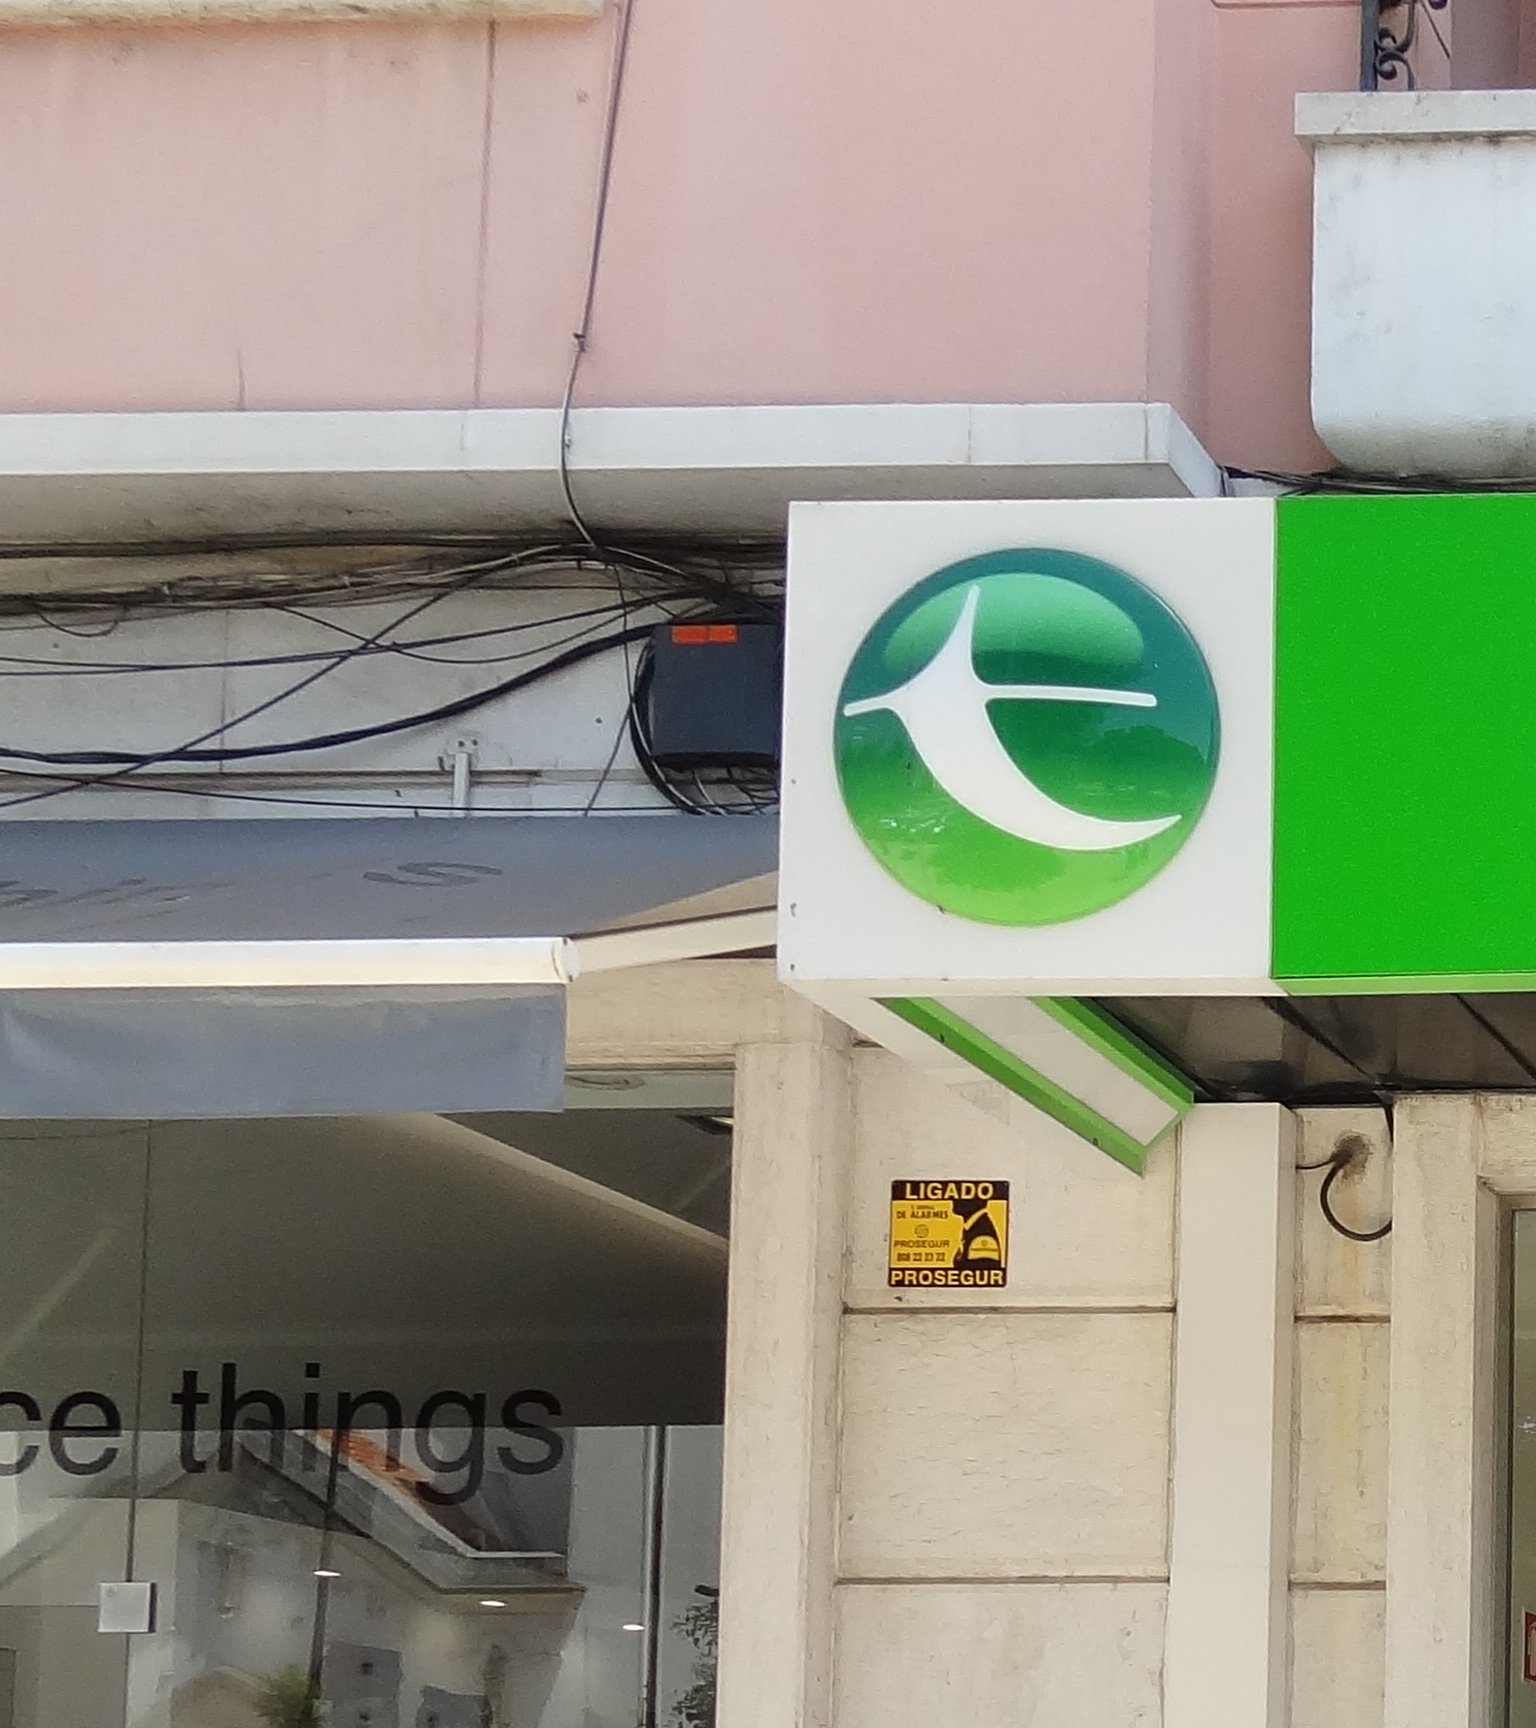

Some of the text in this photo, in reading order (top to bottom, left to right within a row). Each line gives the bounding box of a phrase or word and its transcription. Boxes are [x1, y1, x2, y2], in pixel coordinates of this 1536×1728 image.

[905, 1182, 994, 1200] LIGADO
[910, 1211, 948, 1219] ALARMES
[894, 1240, 950, 1249] PROSEGUR
[890, 1270, 1003, 1285] PROSEGUR
[170, 1361, 565, 1506] things
